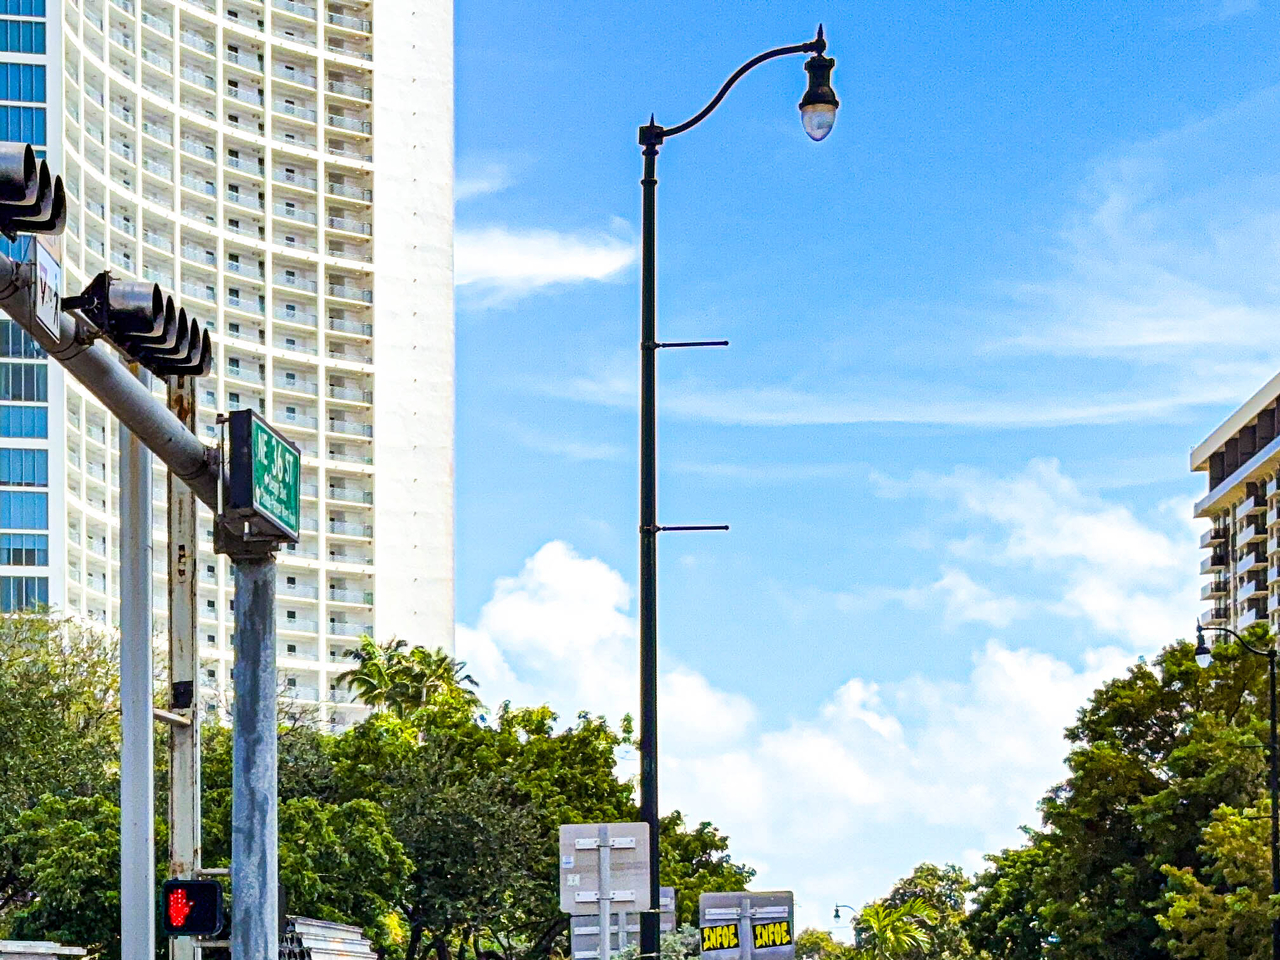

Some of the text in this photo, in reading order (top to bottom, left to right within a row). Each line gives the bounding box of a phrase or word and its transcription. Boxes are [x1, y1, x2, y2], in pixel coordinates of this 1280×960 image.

[258, 429, 294, 485] NE 36 ST
